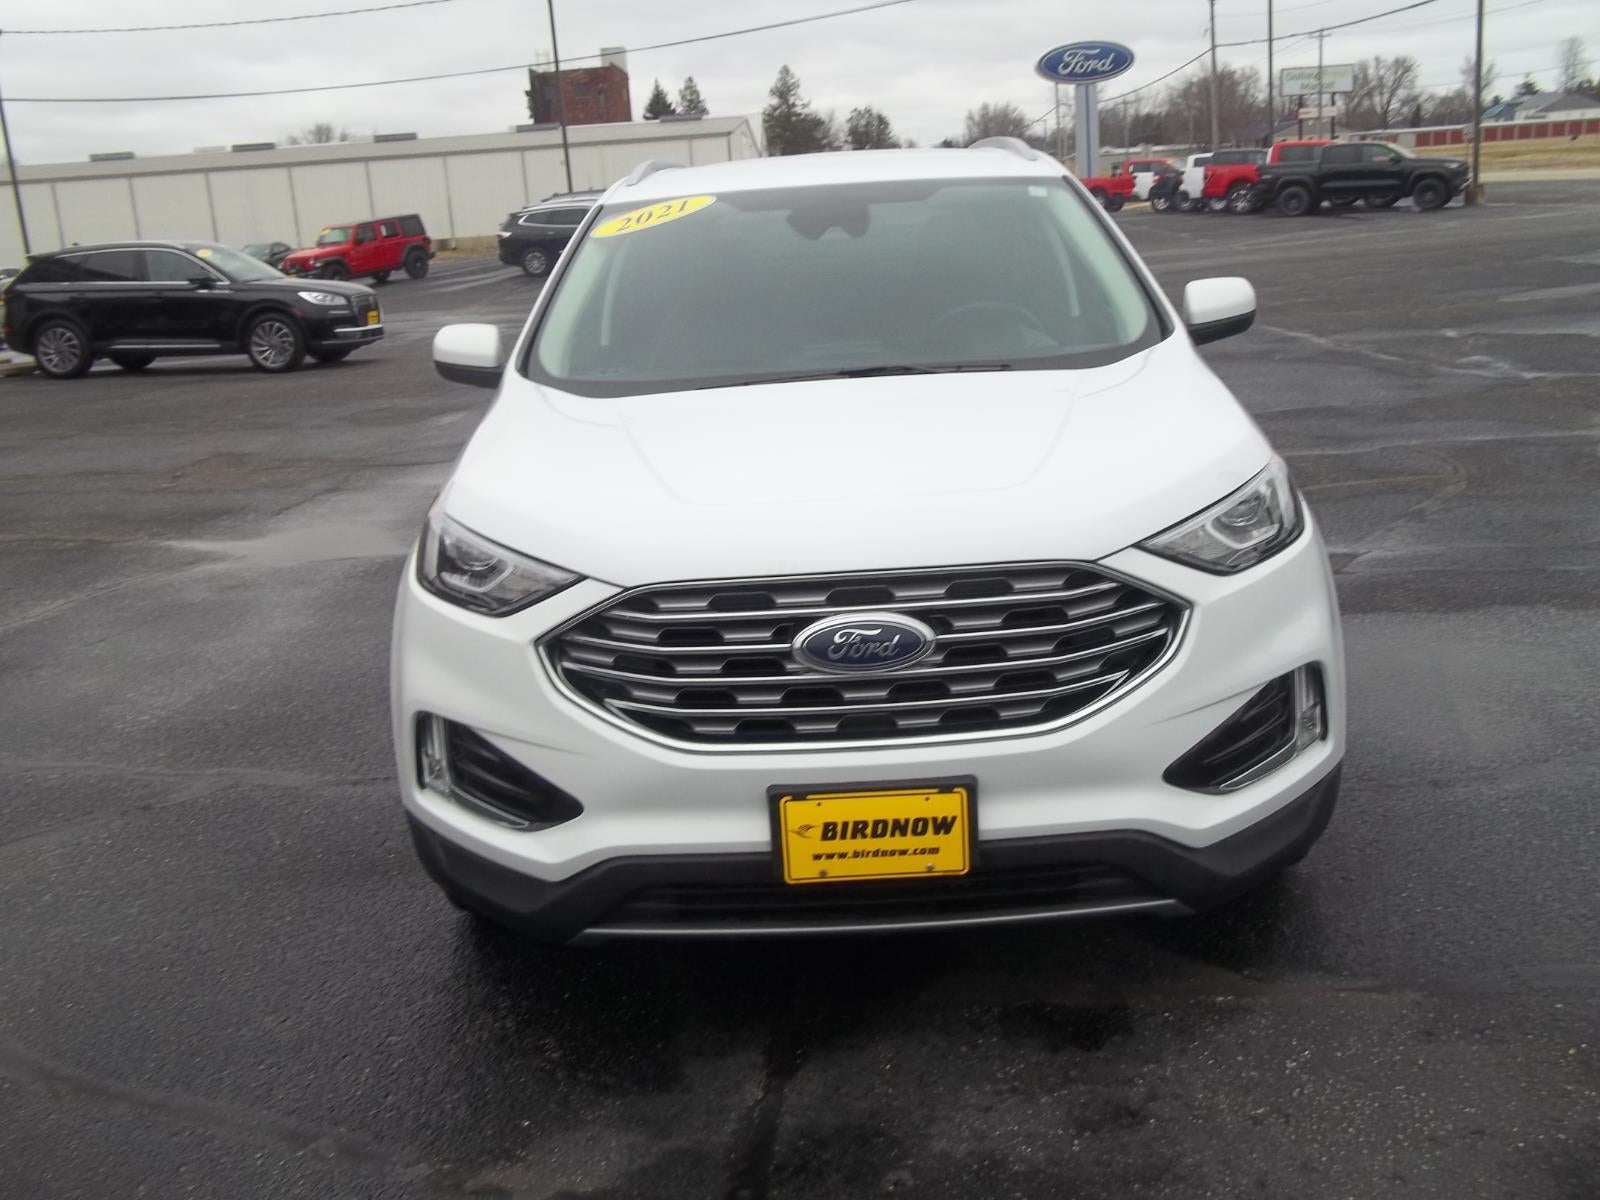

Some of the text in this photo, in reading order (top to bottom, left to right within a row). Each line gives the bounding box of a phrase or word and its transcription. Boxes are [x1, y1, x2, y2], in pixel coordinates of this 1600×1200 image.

[1058, 48, 1115, 75] Ford
[616, 200, 688, 232] 2021
[828, 628, 900, 660] Ford
[821, 815, 958, 842] BIRDNOW
[812, 846, 940, 861] www.birdnow.com
